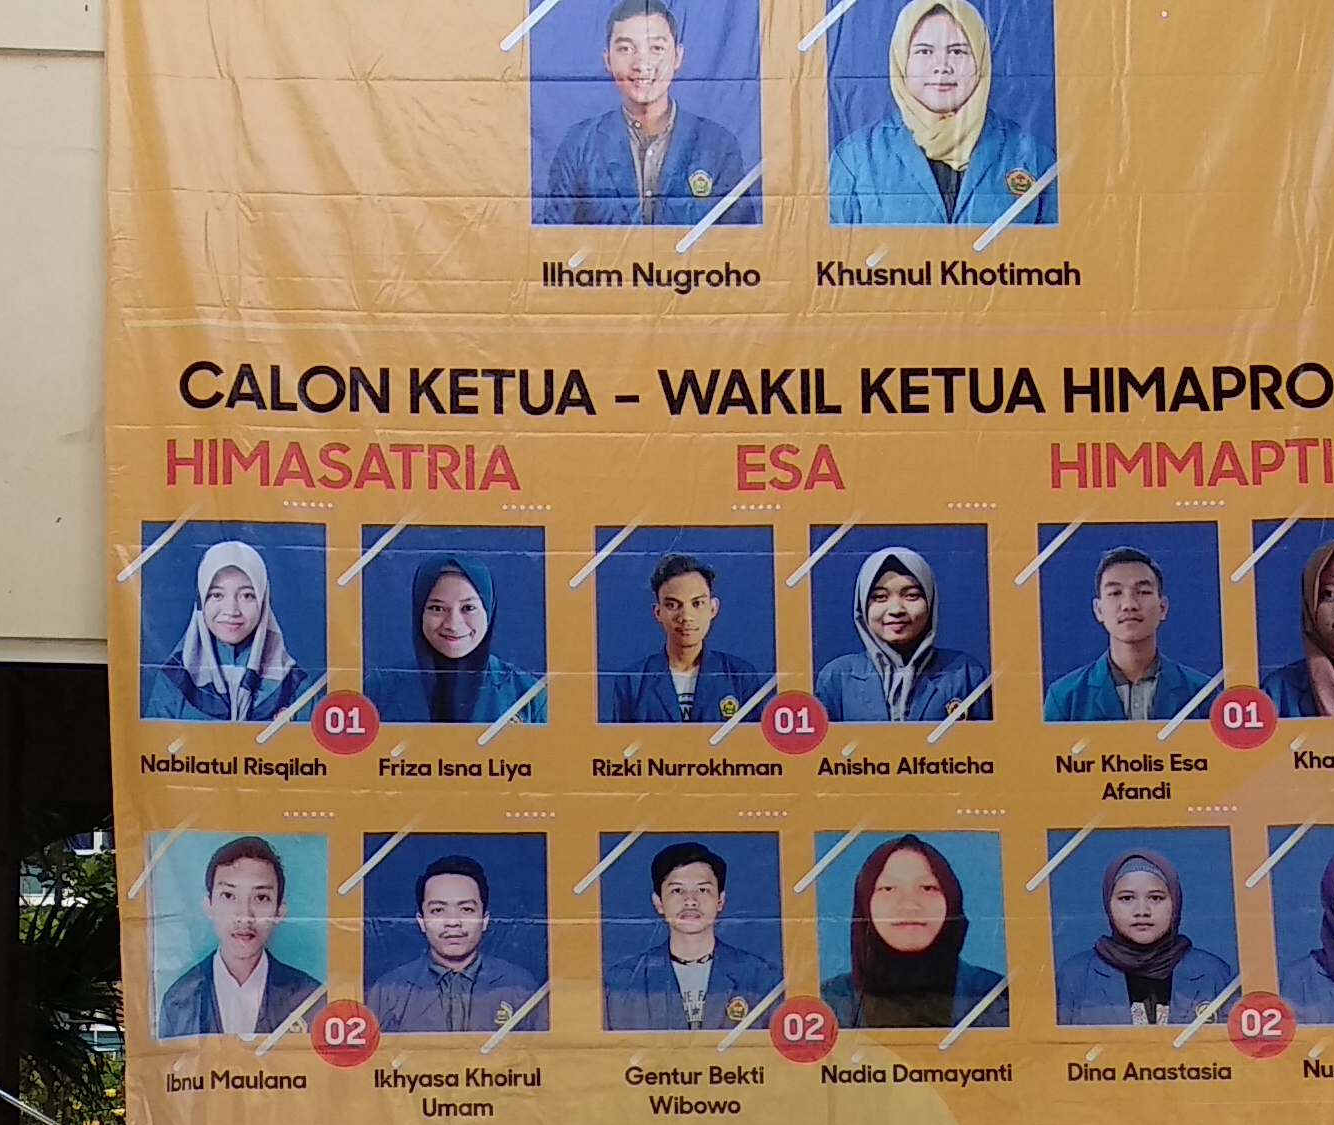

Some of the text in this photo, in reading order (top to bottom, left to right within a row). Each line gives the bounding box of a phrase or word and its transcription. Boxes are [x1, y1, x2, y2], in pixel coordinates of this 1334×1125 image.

[542, 261, 760, 294] Ilham Nugroho
[817, 261, 1080, 286] Khusnul Khotimah
[179, 361, 389, 414] CALON
[410, 368, 596, 416] KETUA
[658, 368, 841, 416] WAKIL
[861, 366, 1046, 414] KETUA
[167, 439, 521, 490] HIMASATRIA
[737, 444, 845, 490] ESA
[324, 708, 366, 735] 01
[774, 709, 815, 735] 01
[1222, 703, 1264, 729] 01
[140, 754, 327, 782] Nabilatul Risqilah
[379, 758, 532, 782] Friza Isna Liya
[592, 758, 782, 777] Rizki Nurrokhman
[817, 756, 993, 776] Anisha Alfaticha
[1056, 753, 1207, 774] Nur Kholis Esa
[1102, 781, 1170, 800] Afandi
[324, 1017, 366, 1045] 02
[783, 1014, 825, 1041] 02
[1240, 1009, 1282, 1036] 02
[167, 1071, 306, 1091] Ibnu Maulana
[374, 1067, 540, 1093] Ikhyasa Khoirul
[625, 1066, 764, 1086] Gentur Bekti
[821, 1064, 1012, 1087] Nadia Damayanti
[1068, 1062, 1231, 1082] Dina Anastasia
[422, 1099, 493, 1118] Umam
[649, 1096, 741, 1115] Wibowo
